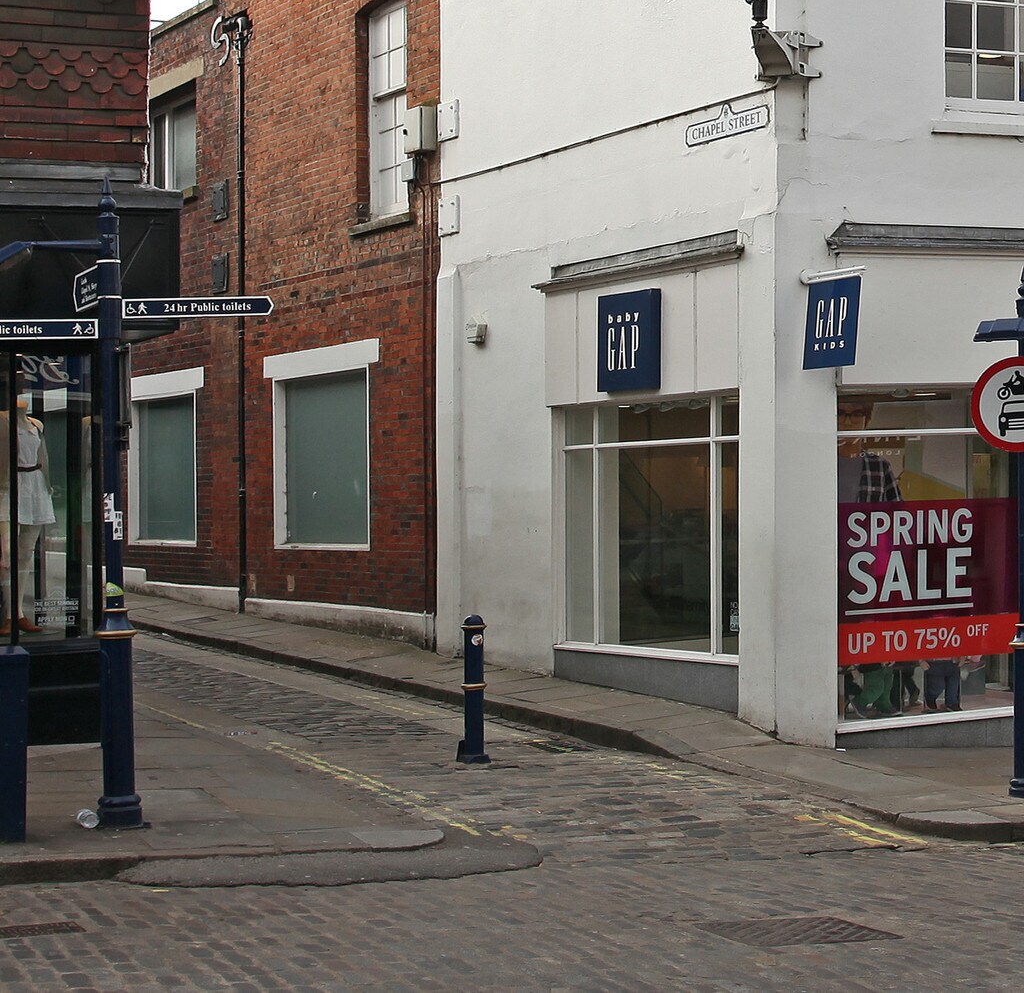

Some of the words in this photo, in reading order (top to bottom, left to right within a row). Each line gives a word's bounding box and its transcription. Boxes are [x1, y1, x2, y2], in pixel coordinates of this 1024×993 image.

[692, 121, 726, 140] CHAPEL
[728, 111, 761, 131] STREET
[163, 303, 175, 312] 24
[177, 303, 188, 312] hr
[190, 302, 220, 312] Public
[222, 302, 252, 311] toilets
[607, 312, 639, 324] baby
[815, 296, 848, 339] GAP
[13, 325, 43, 334] toilets
[607, 325, 639, 371] GAP
[814, 340, 845, 351] KIDS
[846, 507, 974, 548] SPRING
[846, 547, 973, 605] SALE
[848, 632, 876, 655] UP
[882, 630, 907, 651] TO
[914, 627, 961, 650] 75%
[967, 623, 989, 638] OFF
